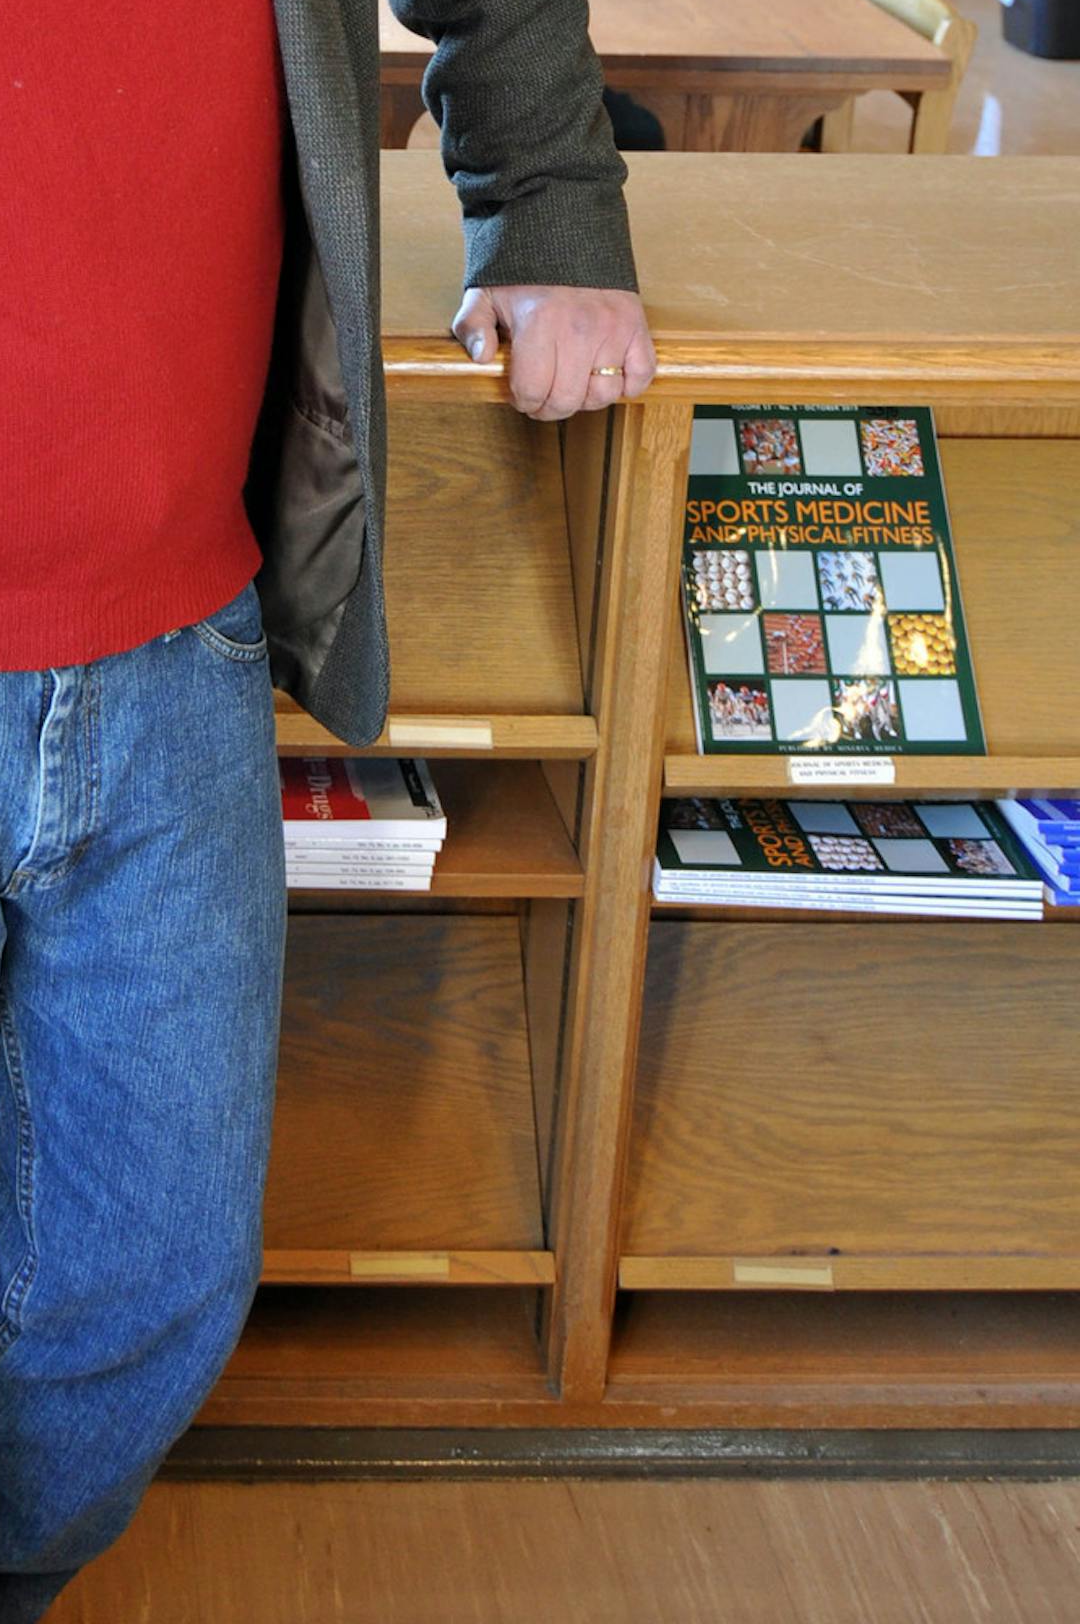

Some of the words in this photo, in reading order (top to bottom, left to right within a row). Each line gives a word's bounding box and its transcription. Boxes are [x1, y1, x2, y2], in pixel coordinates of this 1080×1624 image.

[747, 481, 777, 495] THE
[778, 481, 841, 497] JOURNAL
[843, 482, 864, 496] OF
[686, 500, 789, 524] SPORTS
[795, 501, 931, 525] MEDICINE
[692, 526, 742, 543] AND
[747, 525, 847, 544] PHYSICAL
[851, 526, 934, 545] FITNESS
[783, 835, 815, 868] AND
